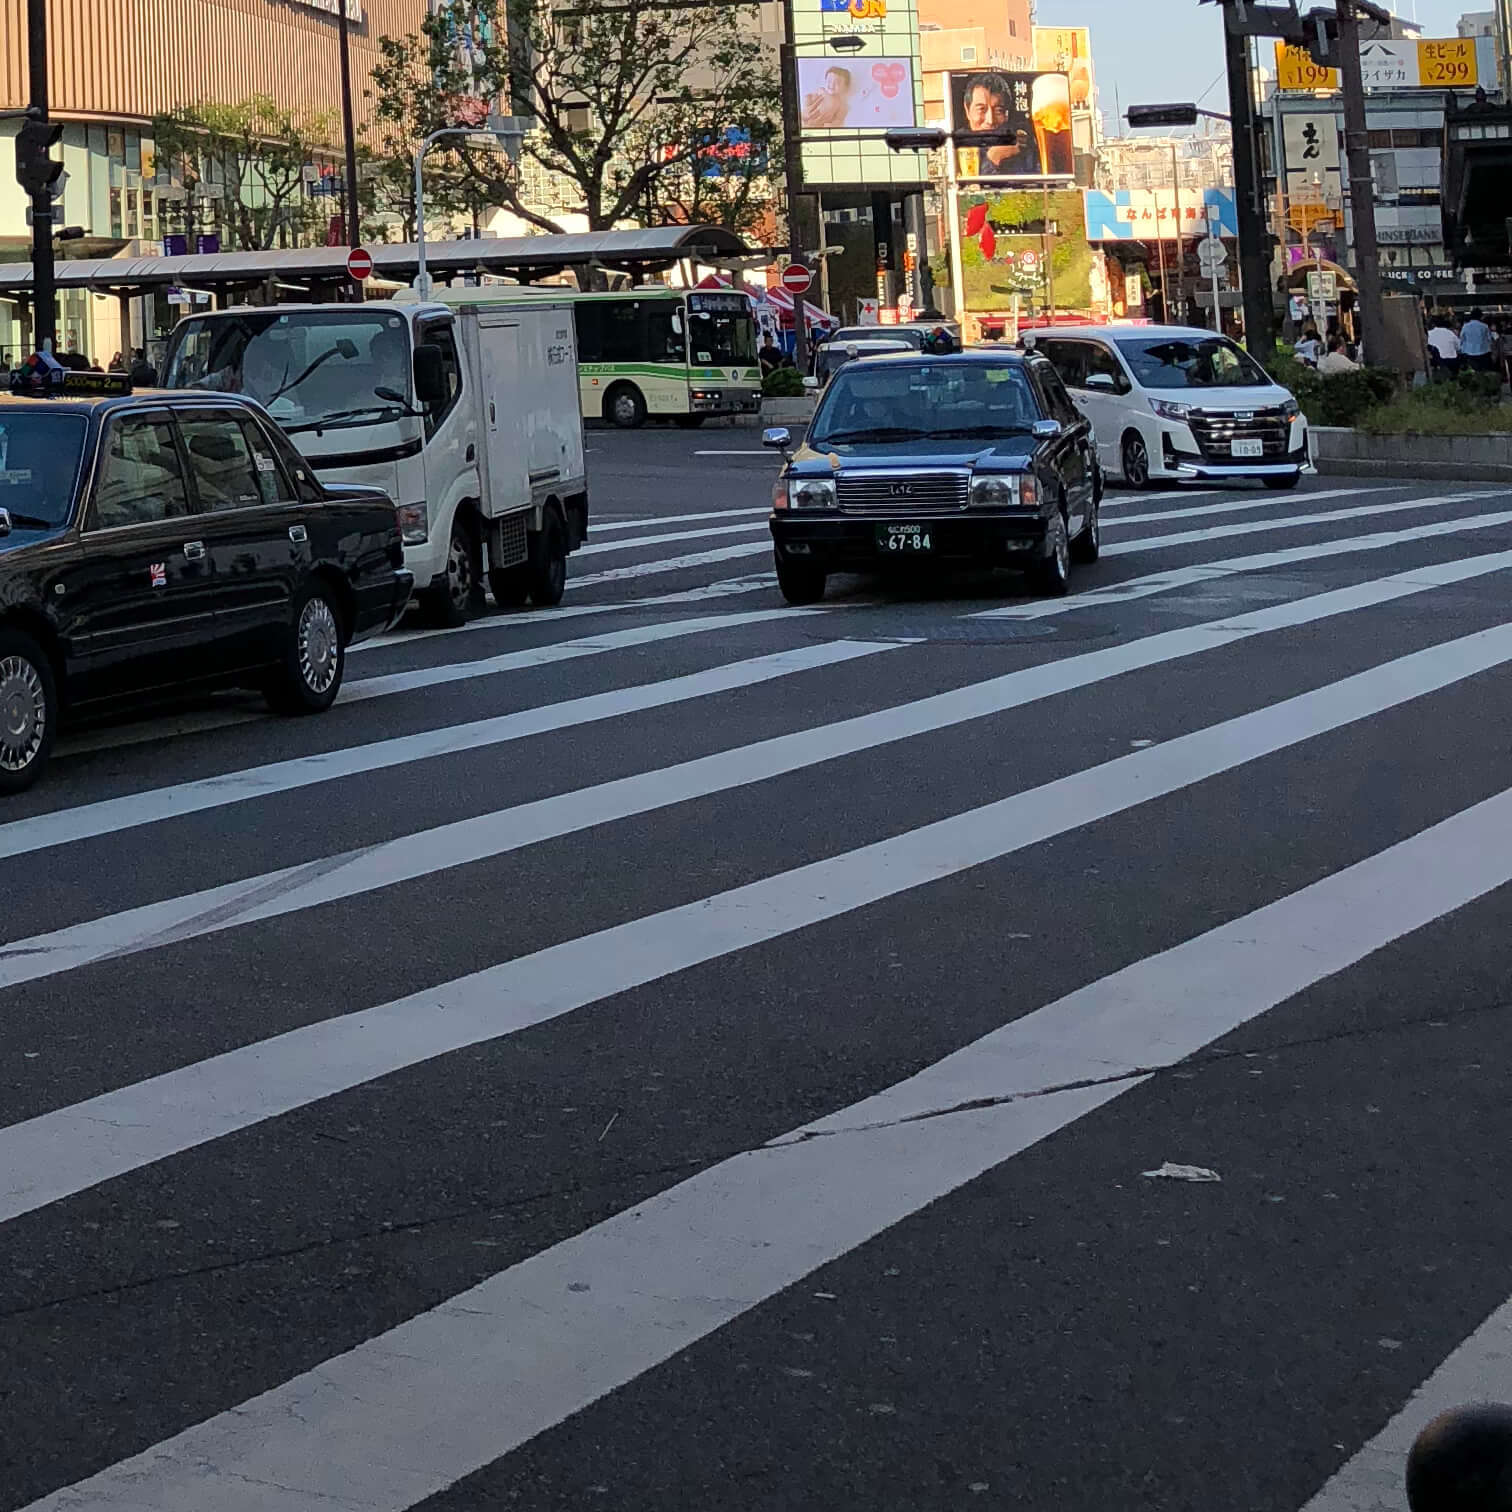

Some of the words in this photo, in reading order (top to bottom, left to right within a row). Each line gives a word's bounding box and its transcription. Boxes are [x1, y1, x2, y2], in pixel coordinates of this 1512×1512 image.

[1424, 44, 1467, 59] 生ビール
[1360, 69, 1406, 81] ライザカ
[888, 534, 931, 550] 67-84
